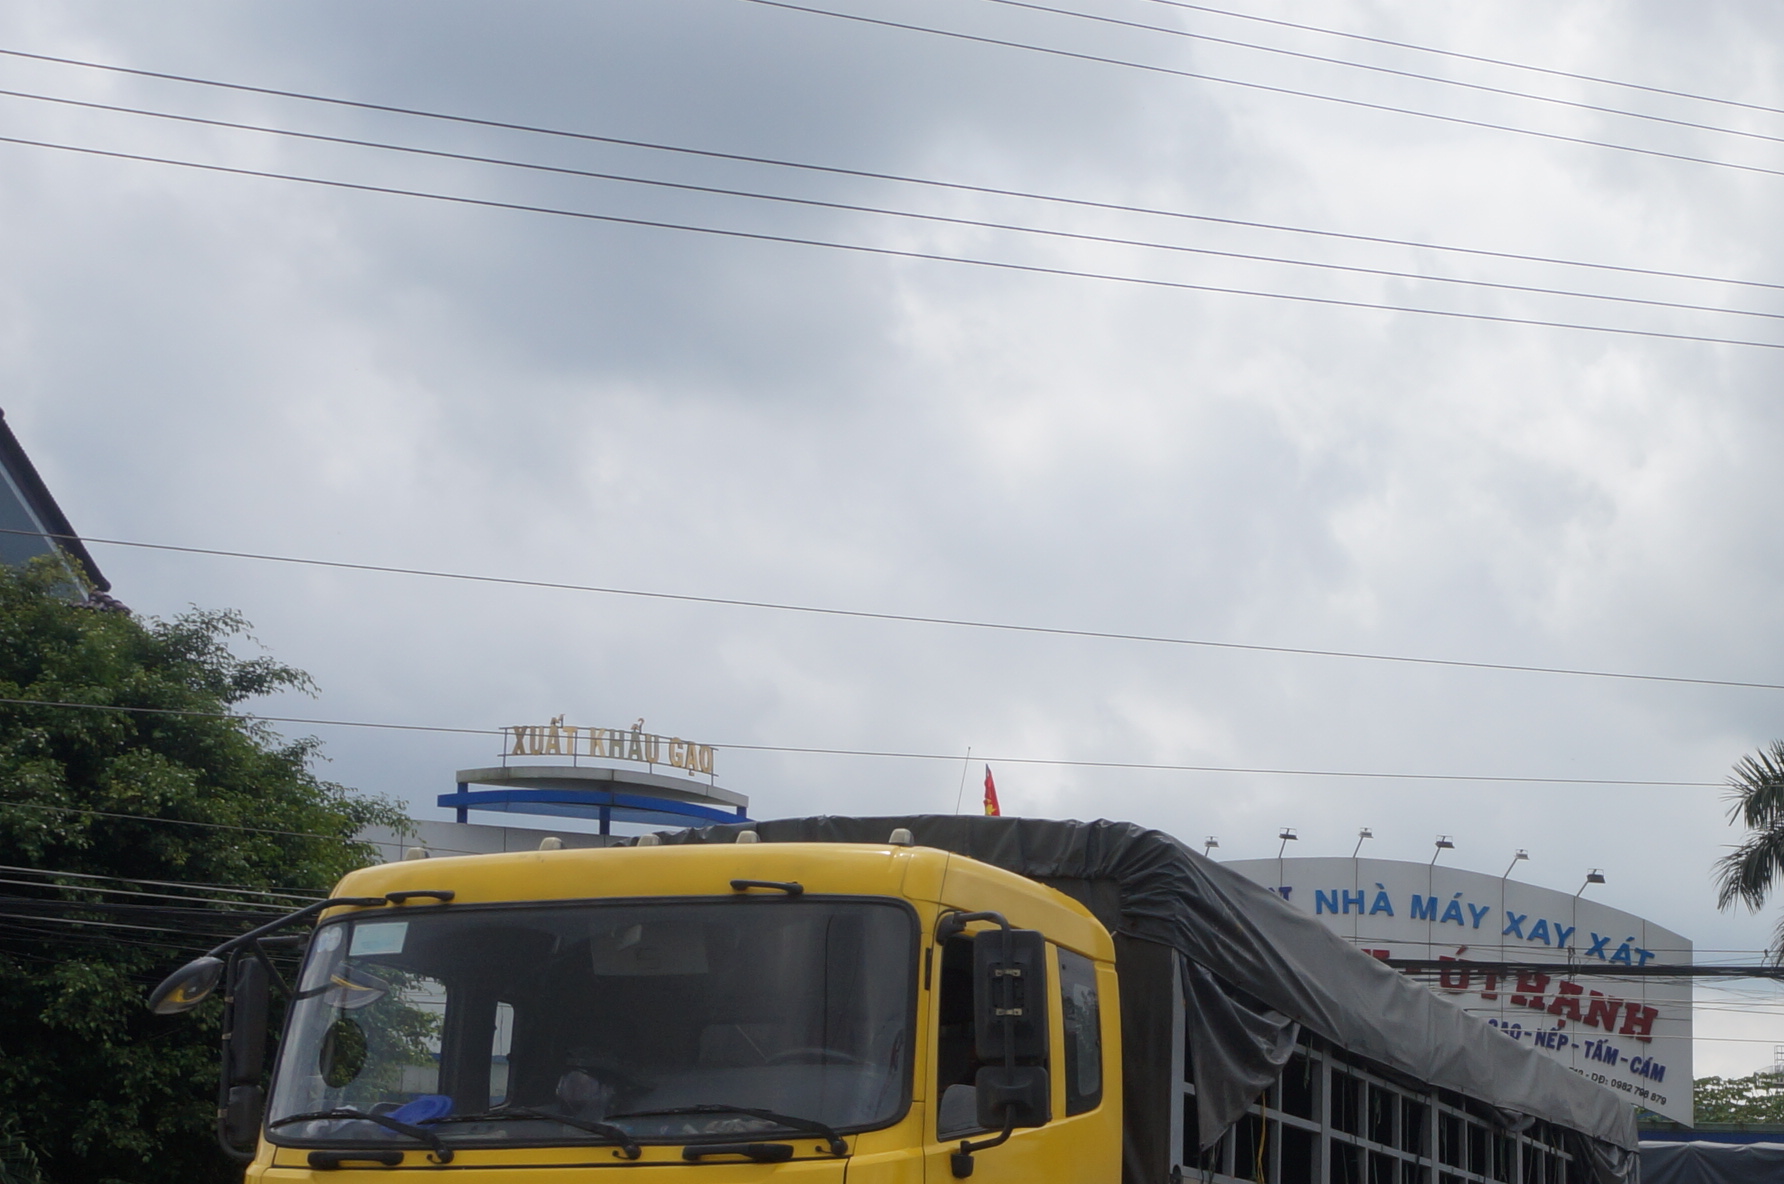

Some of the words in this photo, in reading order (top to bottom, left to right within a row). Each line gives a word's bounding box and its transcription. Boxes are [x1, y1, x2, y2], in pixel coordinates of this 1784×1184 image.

[512, 713, 578, 756] XUẤT
[588, 717, 660, 764] KHẨU
[668, 736, 714, 777] GẠO
[1315, 882, 1395, 917] NHÀ
[1409, 892, 1490, 929] MÁY
[1502, 910, 1576, 950] XAY
[1584, 932, 1656, 967] XÁT
[1584, 1038, 1620, 1067] TẤM
[1629, 1056, 1667, 1083] CÁM
[1610, 1078, 1633, 1093] 0982
